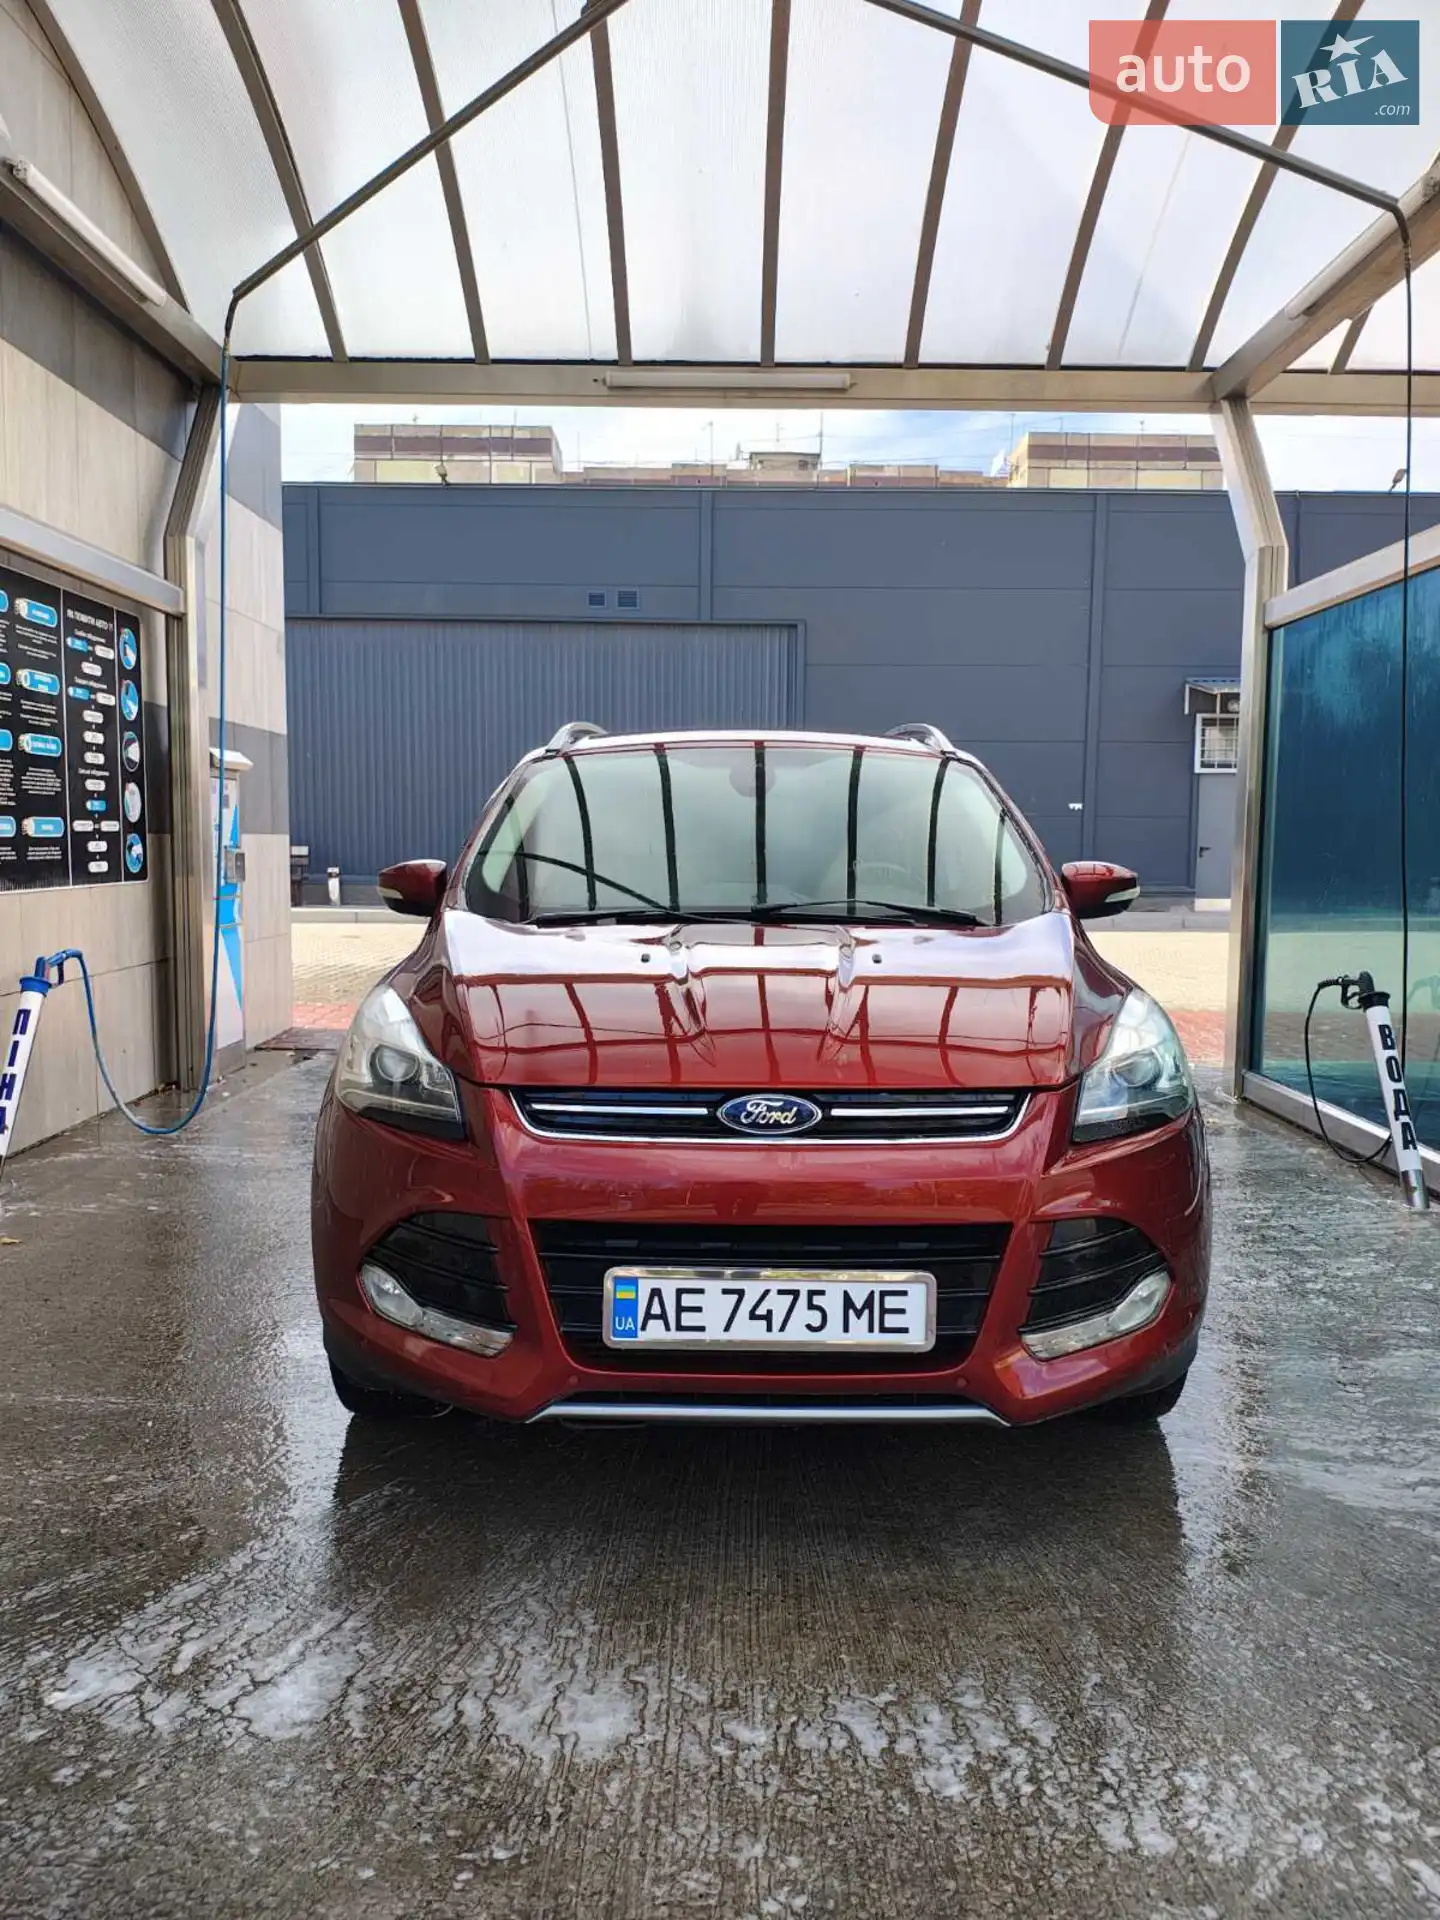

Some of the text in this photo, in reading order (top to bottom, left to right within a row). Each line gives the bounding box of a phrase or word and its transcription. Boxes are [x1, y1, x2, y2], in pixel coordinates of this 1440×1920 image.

[1377, 1023, 1418, 1150] ВОДА
[740, 1099, 798, 1125] Ford
[615, 1315, 636, 1331] UA
[640, 1287, 911, 1334] AE 7475 ME
